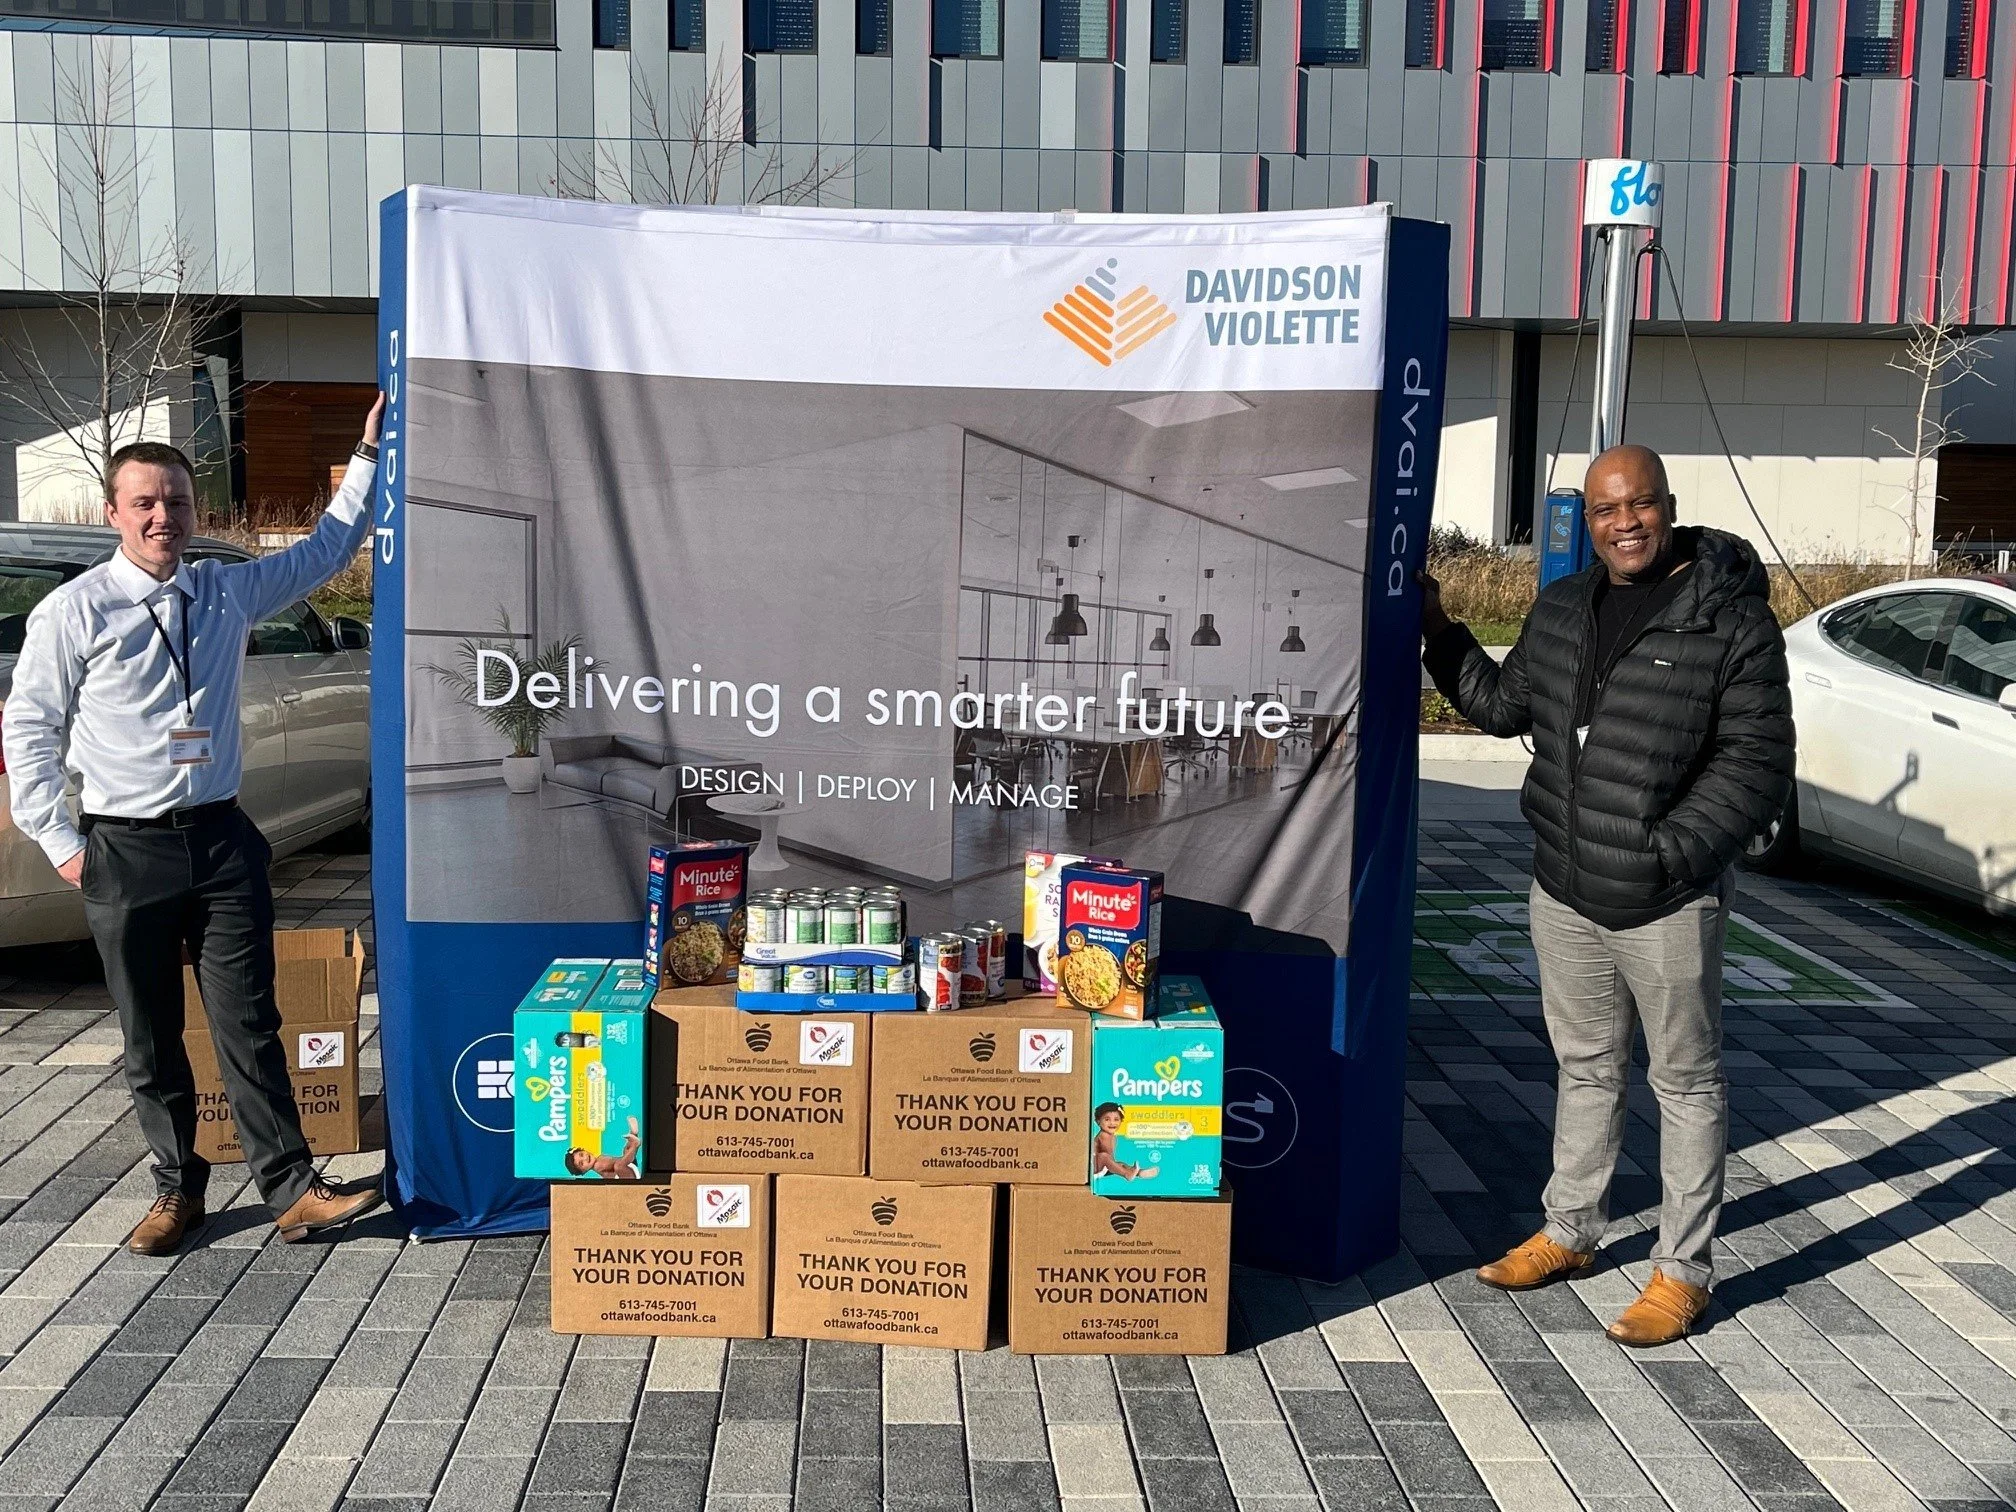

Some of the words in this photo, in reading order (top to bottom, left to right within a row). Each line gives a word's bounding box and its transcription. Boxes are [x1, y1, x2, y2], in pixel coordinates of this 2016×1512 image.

[1610, 161, 1661, 215] flo
[1185, 264, 1361, 304] DAVIDSON
[1204, 308, 1360, 347] VIOLETTE
[376, 329, 399, 565] dvai.ca
[1387, 357, 1430, 597] dvai.ca
[1560, 505, 1573, 516] flo
[476, 647, 781, 738] Delivering
[804, 684, 841, 724] a
[864, 682, 1096, 733] smarter
[1116, 671, 1291, 739] future
[681, 765, 784, 797] DESIGN
[817, 774, 917, 804] DEPLOY
[948, 779, 1079, 811] MANAGE
[680, 867, 735, 886] Minute
[695, 884, 721, 897] Rice
[1073, 888, 1132, 911] Minute
[1089, 906, 1116, 922] Rice
[1070, 935, 1081, 944] 10
[316, 1043, 338, 1065] Mosaic
[818, 1035, 845, 1062] Mosaic
[1038, 1043, 1066, 1070] Mosaic
[709, 1065, 734, 1073] Banque
[726, 1057, 750, 1065] Ottawa
[672, 1083, 745, 1101] THANK
[749, 1085, 792, 1102] YOU
[799, 1087, 842, 1103] FOR
[1112, 1068, 1203, 1101] Pampers
[195, 1092, 229, 1106] THA
[302, 1084, 338, 1098] FOR
[538, 1055, 572, 1142] Pampers
[577, 1071, 585, 1126] swaddlers
[896, 1094, 969, 1110] THANK
[973, 1095, 1016, 1111] YOU
[1024, 1096, 1066, 1112] FOR
[298, 1101, 340, 1115] TION
[670, 1104, 727, 1121] YOUR
[735, 1106, 844, 1123] DONATION
[1130, 1110, 1185, 1119] swaddlers
[894, 1114, 952, 1131] YOUR
[959, 1115, 1068, 1133] DONATION
[1200, 1116, 1207, 1127] 3
[716, 1136, 795, 1147] 613-745-7001
[697, 1148, 814, 1160] ottawafoodbank.ca
[940, 1146, 1019, 1157] 613-745-7001
[922, 1157, 1039, 1170] ottawafoodbank.ca
[716, 1199, 743, 1225] Mosaic
[627, 1221, 652, 1229] Ottawa
[853, 1229, 877, 1237] Ottawa
[574, 1248, 647, 1264] THANK
[651, 1249, 693, 1265] YOU
[700, 1250, 743, 1266] FOR
[799, 1253, 870, 1273] THANK
[875, 1257, 917, 1275] YOU
[924, 1261, 966, 1279] FOR
[572, 1268, 630, 1284] YOUR
[637, 1269, 745, 1287] DONATION
[1036, 1267, 1110, 1283] THANK
[1114, 1267, 1156, 1283] YOU
[1163, 1267, 1207, 1283] FOR
[797, 1273, 853, 1292] YOUR
[860, 1277, 968, 1299] DONATION
[1035, 1288, 1092, 1303] YOUR
[1100, 1287, 1208, 1303] DONATION
[619, 1300, 697, 1311] 613-745-7001
[842, 1307, 919, 1321] 613-745-7001
[600, 1311, 716, 1323] ottawafoodbank.ca
[1081, 1318, 1159, 1328] 613-745-7001
[823, 1319, 938, 1335] ottawafoodbank.ca
[1062, 1329, 1178, 1340] ottawafoodbank.ca
